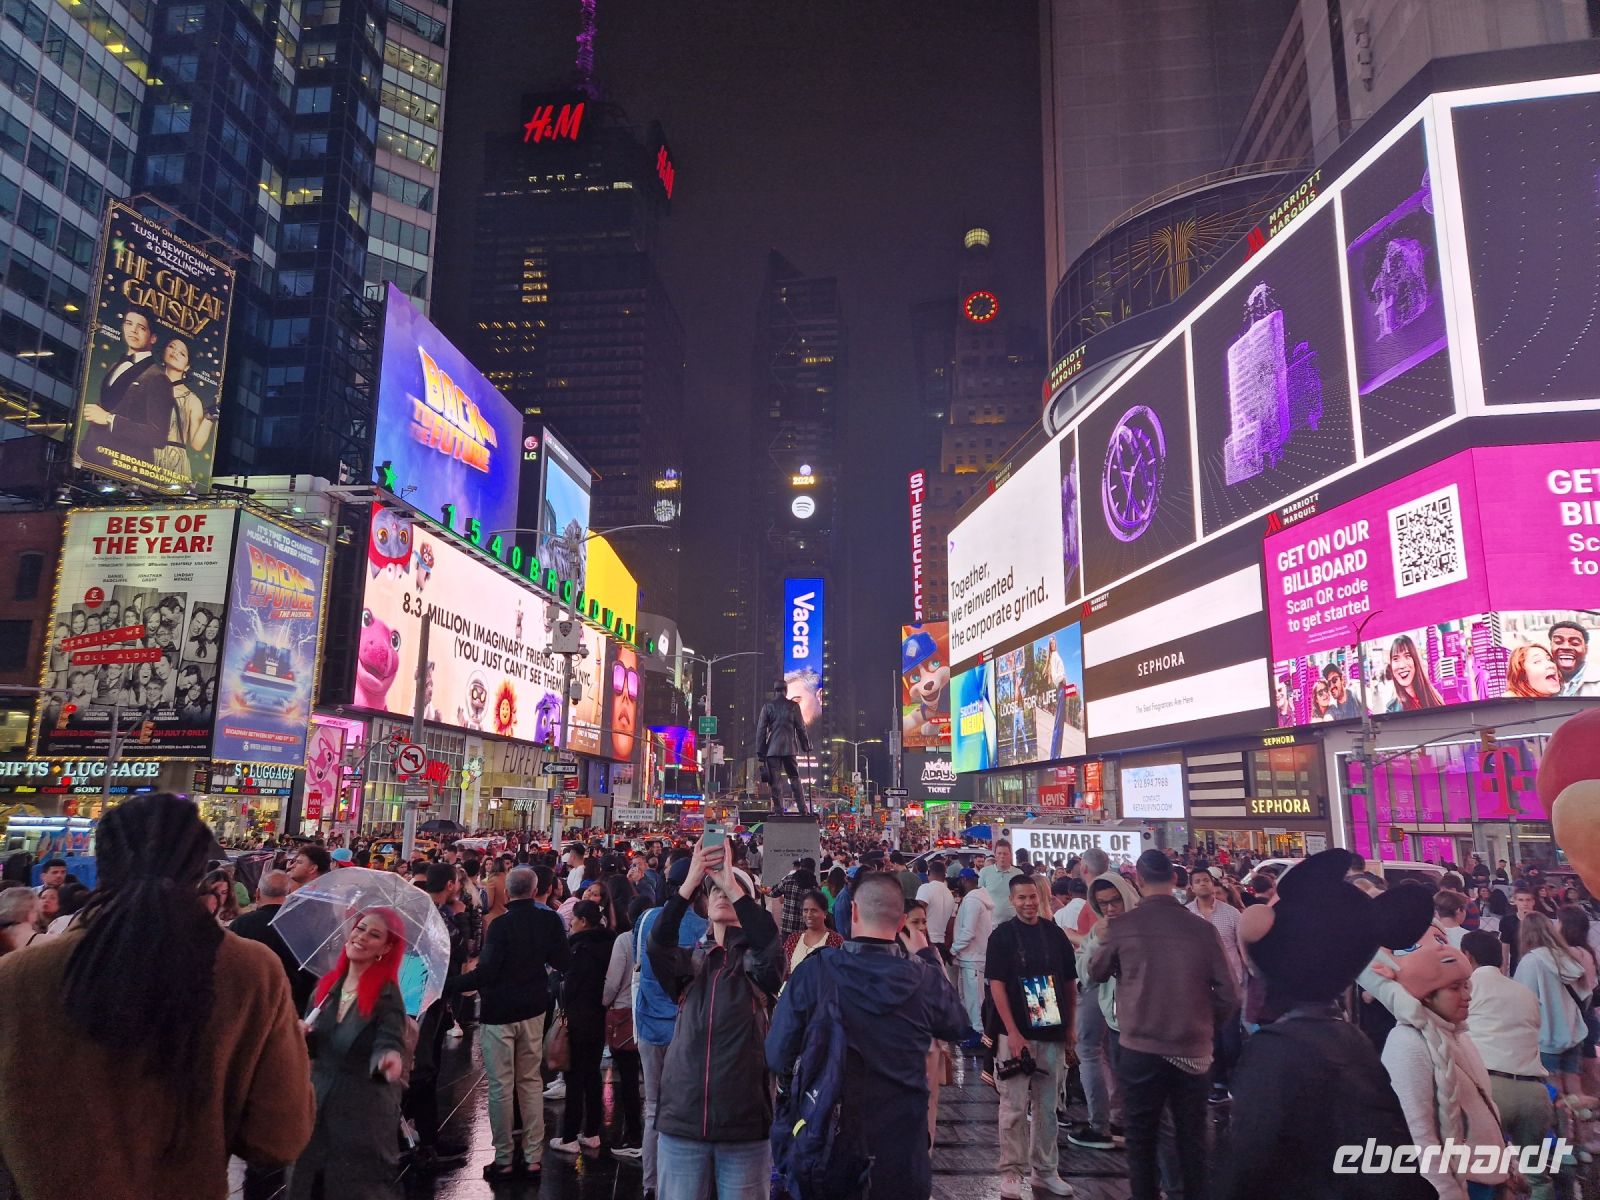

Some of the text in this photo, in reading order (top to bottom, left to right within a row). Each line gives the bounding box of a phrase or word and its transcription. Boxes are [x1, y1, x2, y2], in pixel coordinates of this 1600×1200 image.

[524, 102, 585, 143] H&M
[1269, 169, 1322, 224] MARRIOTT
[1269, 190, 1317, 238] MARQUIS
[143, 217, 209, 259] NOW ON BROADWAY
[146, 241, 154, 251] &
[161, 239, 216, 277] BEWITCHING
[112, 249, 153, 286] THE
[156, 269, 224, 322] GREAT
[123, 279, 211, 335] GATSBY
[1050, 345, 1087, 380] MARRIOTT
[1050, 360, 1082, 392] MARQUIS
[418, 345, 498, 449] BACK
[119, 453, 162, 473] BROADWAY
[524, 452, 537, 460] LG
[139, 468, 179, 485] BROADWAY
[793, 476, 815, 485] 2024
[1282, 493, 1320, 516] MARRIOTT
[1283, 505, 1317, 526] MARQUIS
[107, 514, 208, 534] BEST OF
[92, 535, 215, 555] THE YEAR!
[246, 529, 272, 546] MUSICAL
[273, 542, 298, 558] THEATER
[282, 535, 291, 545] TO
[290, 539, 314, 555] CHANGE
[1278, 519, 1370, 572] GET ON OUR
[246, 542, 316, 593] BACK
[1283, 548, 1368, 596] BILLBOARD
[1570, 556, 1599, 576] to
[951, 562, 990, 600] Together,
[403, 592, 423, 618] 8.3
[951, 566, 1015, 625] we reinvented
[1286, 578, 1369, 615] Scan QR code
[279, 610, 291, 618] THE
[792, 591, 815, 659] Vacra
[951, 576, 1050, 650] the corporate grind.
[1288, 595, 1370, 633] to get started
[61, 627, 141, 649] MERRILY WE
[427, 603, 471, 638] MILLION
[473, 623, 524, 658] IMAGINARY
[525, 646, 555, 672] FRIENDS
[76, 654, 106, 662] ROLL
[481, 648, 503, 671] JUST
[529, 667, 541, 685] SEE
[1137, 651, 1185, 677] SEPHORA
[1023, 695, 1038, 709] FOR
[1042, 689, 1057, 705] LIFE
[1263, 734, 1295, 746] SEPHORA
[0, 762, 160, 777] GIFTS LUGGAGE
[249, 764, 295, 780] LUGGAGE
[1251, 799, 1311, 813] SEPHORA
[1030, 832, 1131, 851] BEWARE OF
